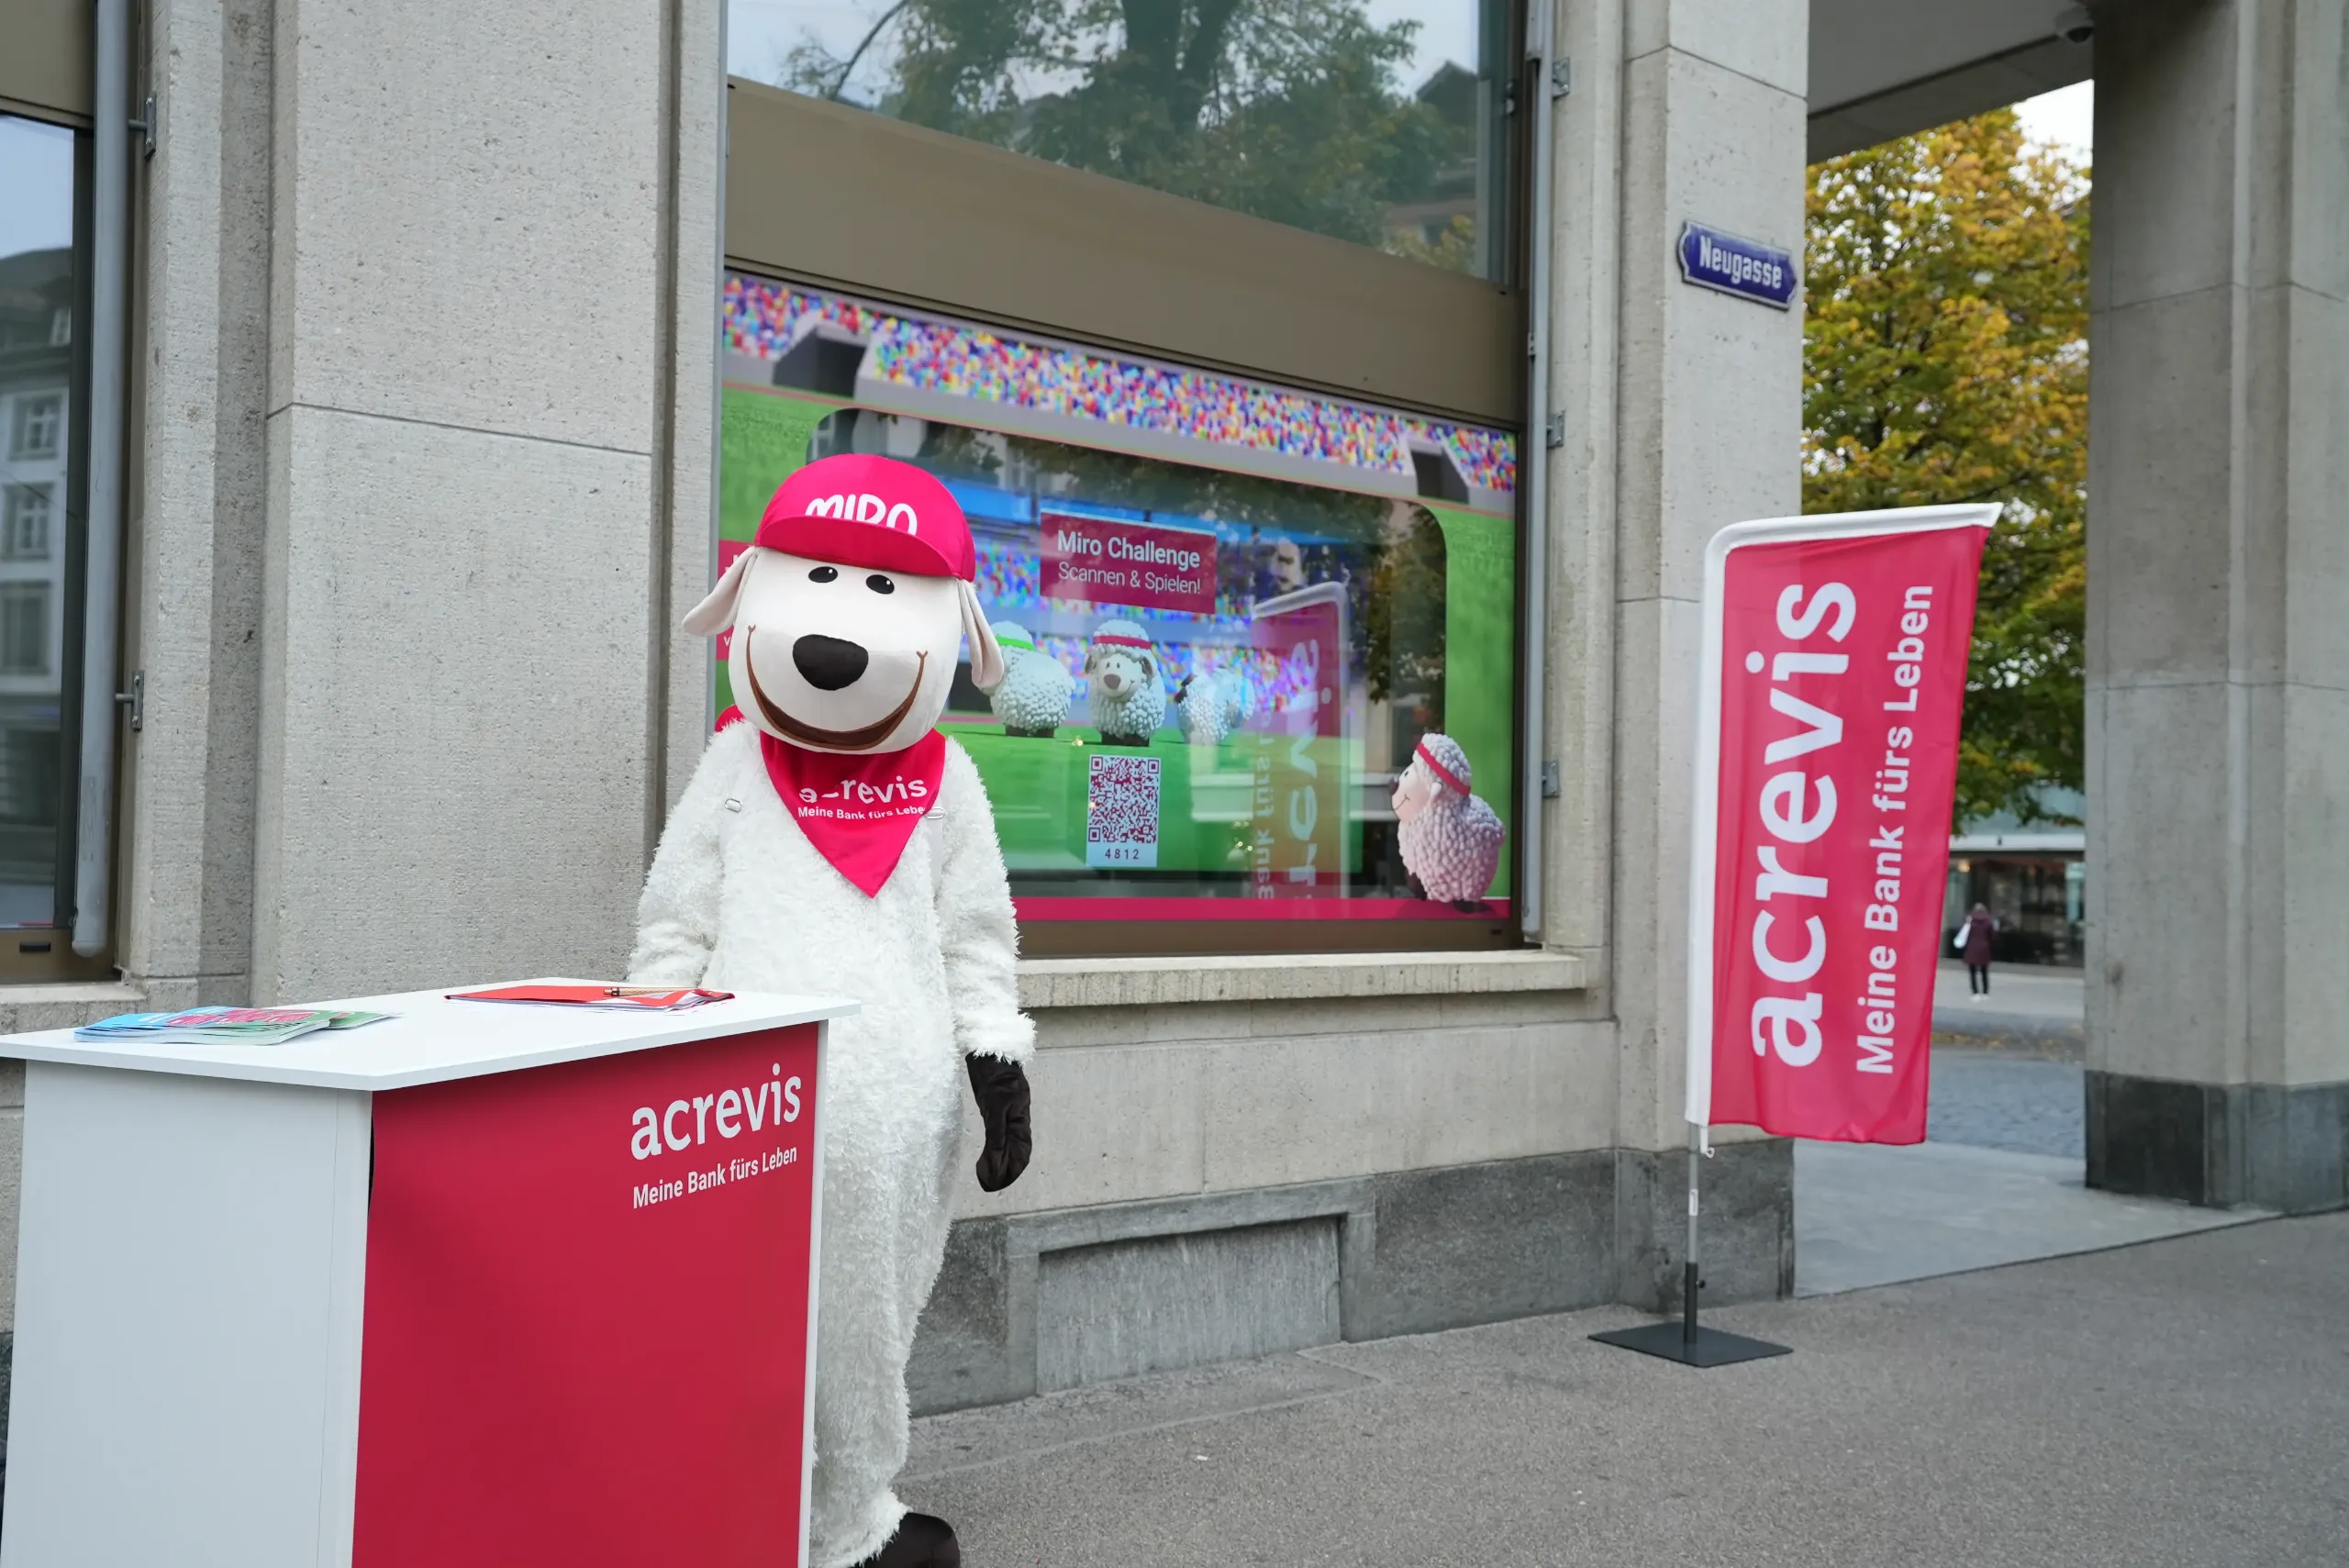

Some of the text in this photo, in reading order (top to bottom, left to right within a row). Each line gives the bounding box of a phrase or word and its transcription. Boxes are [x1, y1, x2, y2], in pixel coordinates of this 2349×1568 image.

[1699, 235, 1783, 289] Neugasse
[1057, 529, 1200, 572] Miro Challenge
[1058, 562, 1201, 595] Scannen & Spielen!
[797, 806, 926, 819] Meine Bank fürs Lebe
[1745, 582, 1857, 1067] acrevis
[1856, 585, 1933, 1074] Meine Bank fürs Leben
[1105, 849, 1139, 860] 4812
[631, 1062, 801, 1160] acrevis
[633, 1146, 797, 1209] Meine Bank fürs Leben
